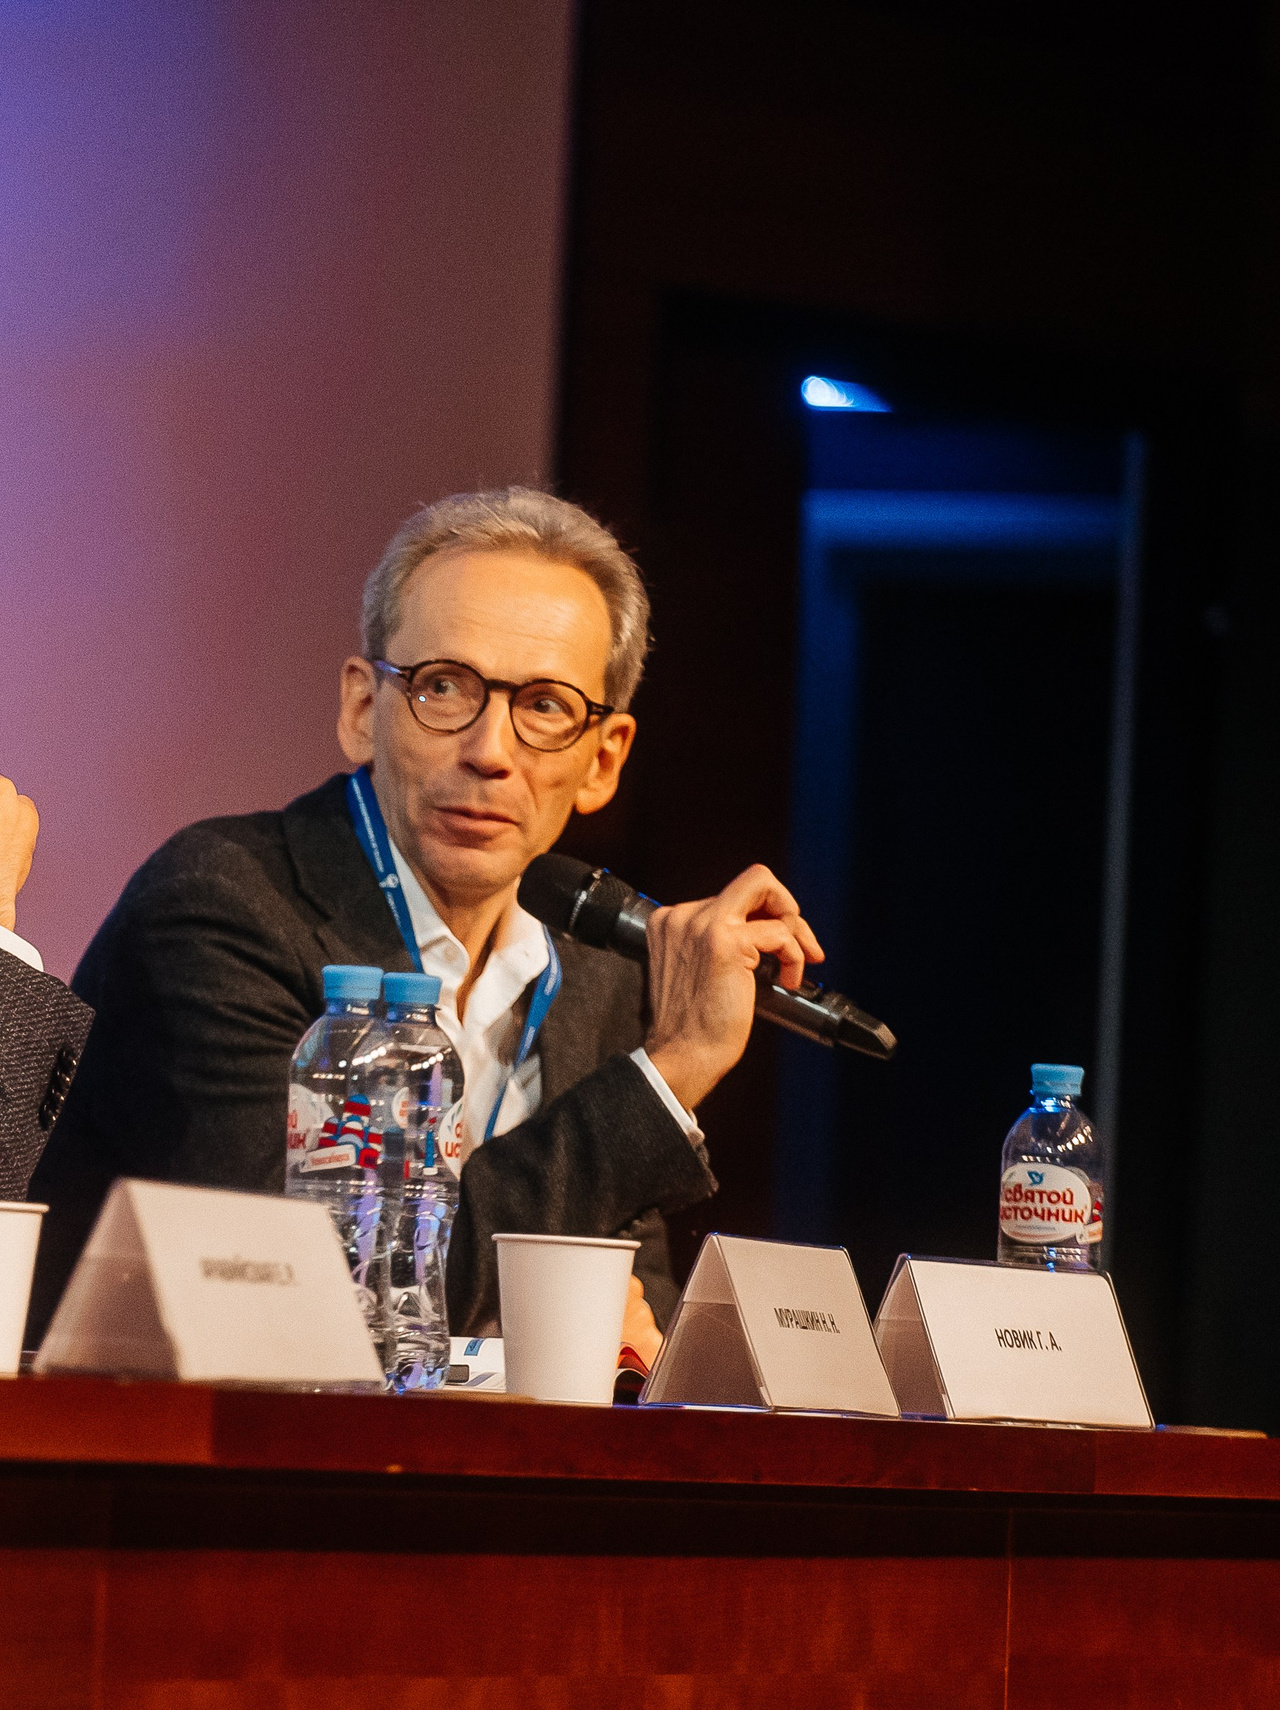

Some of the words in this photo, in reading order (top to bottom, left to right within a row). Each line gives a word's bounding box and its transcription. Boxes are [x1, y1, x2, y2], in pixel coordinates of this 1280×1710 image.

[994, 1327, 1038, 1350] НОВИК
[1035, 1330, 1049, 1351] Г.
[1048, 1330, 1062, 1352] А.
